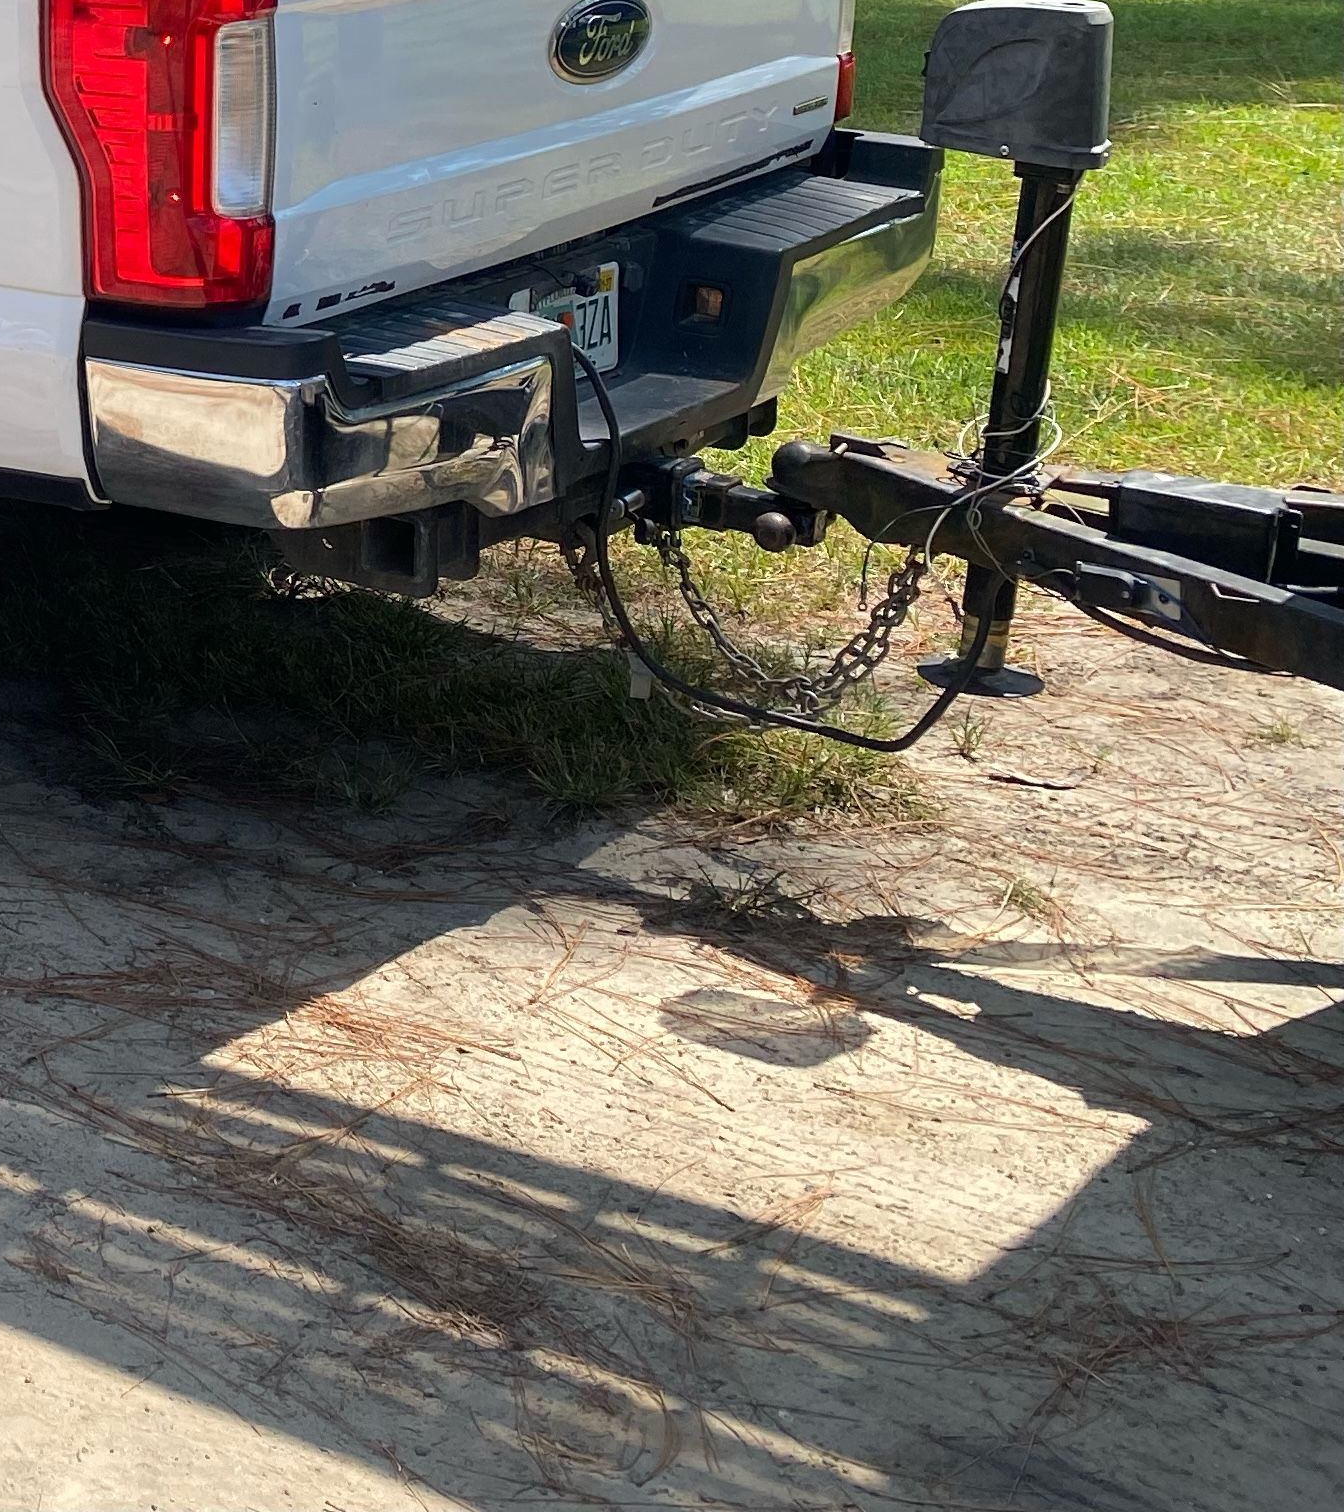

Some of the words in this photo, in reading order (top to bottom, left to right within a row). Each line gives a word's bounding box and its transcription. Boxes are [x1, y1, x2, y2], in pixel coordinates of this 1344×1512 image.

[578, 12, 635, 66] Ford
[386, 150, 623, 243] SUPER
[641, 104, 778, 171] DUTY
